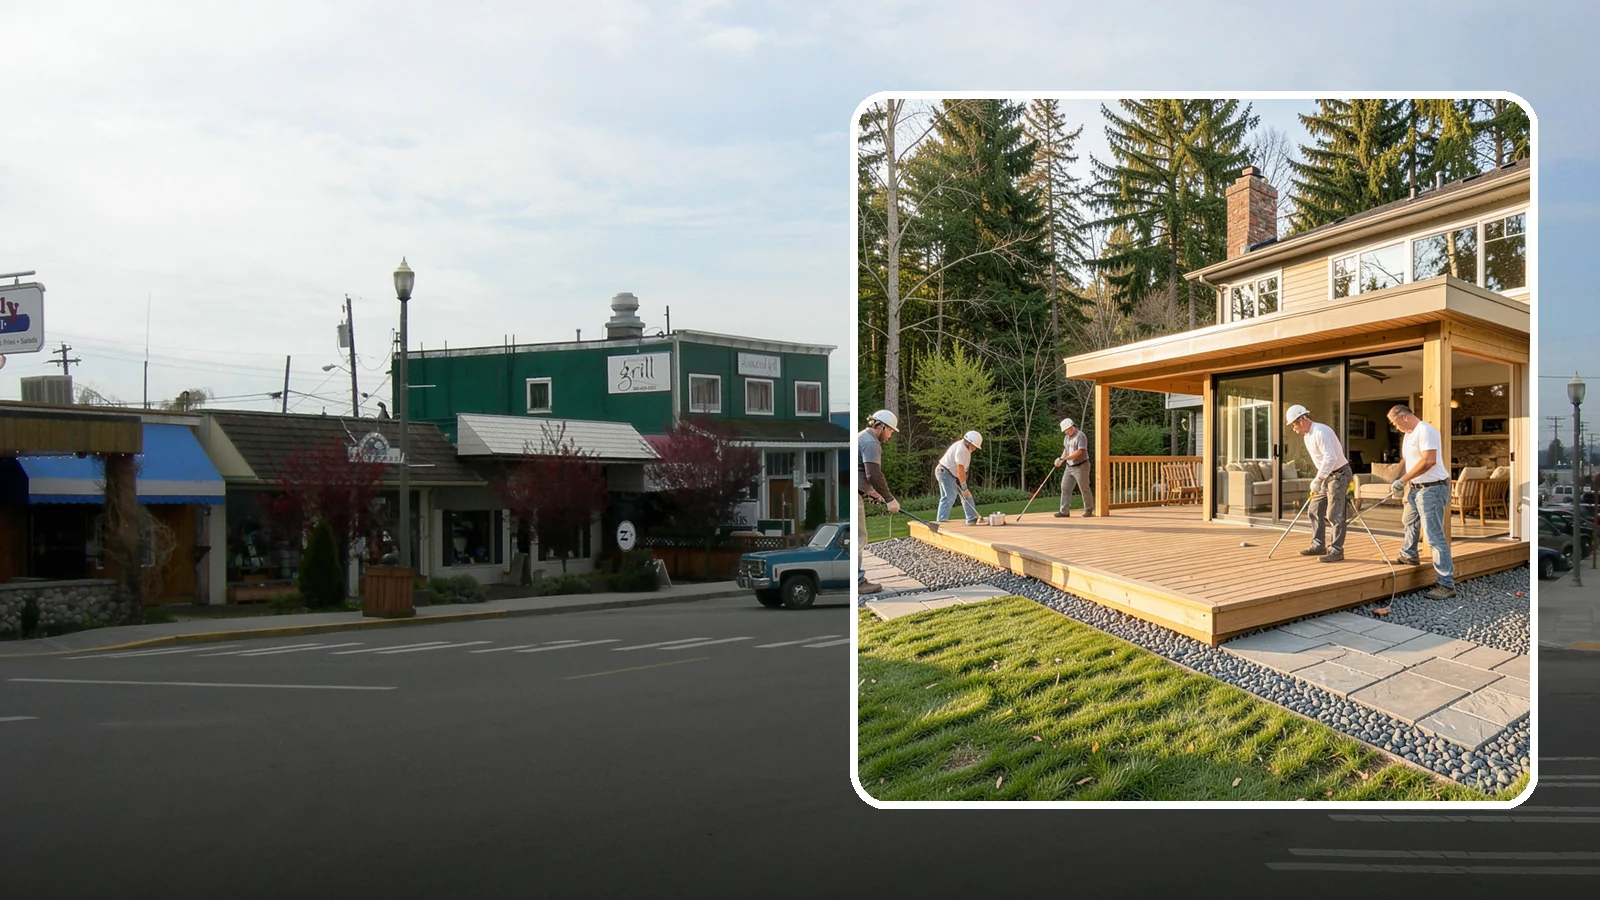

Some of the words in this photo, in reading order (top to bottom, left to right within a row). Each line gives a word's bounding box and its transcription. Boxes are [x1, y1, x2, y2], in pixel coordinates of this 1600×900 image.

[3, 338, 16, 346] Fries
[20, 336, 38, 345] Salads
[618, 356, 655, 391] grill
